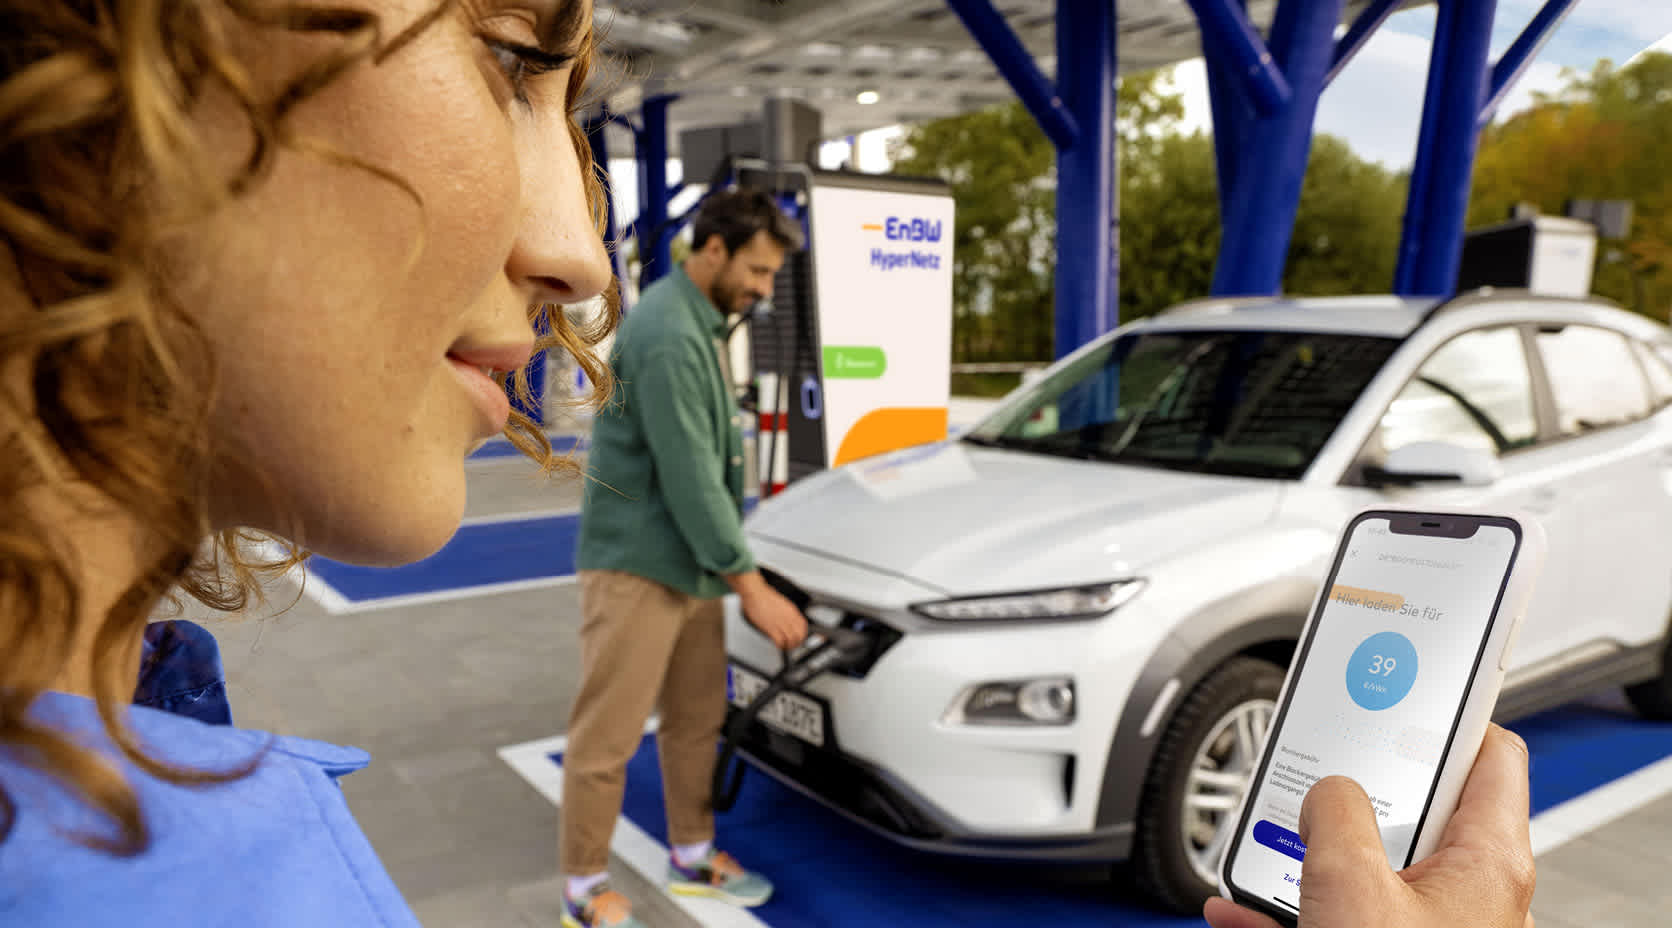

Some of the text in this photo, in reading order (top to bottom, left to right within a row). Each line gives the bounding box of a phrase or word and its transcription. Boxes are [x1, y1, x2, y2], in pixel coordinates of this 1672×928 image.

[885, 216, 942, 242] EnBW
[870, 248, 941, 270] HyperNetz
[1336, 592, 1444, 622] Hier laden Sie für
[1367, 654, 1397, 677] 39
[1276, 836, 1294, 849] Jetzt
[1283, 873, 1295, 884] Zur
